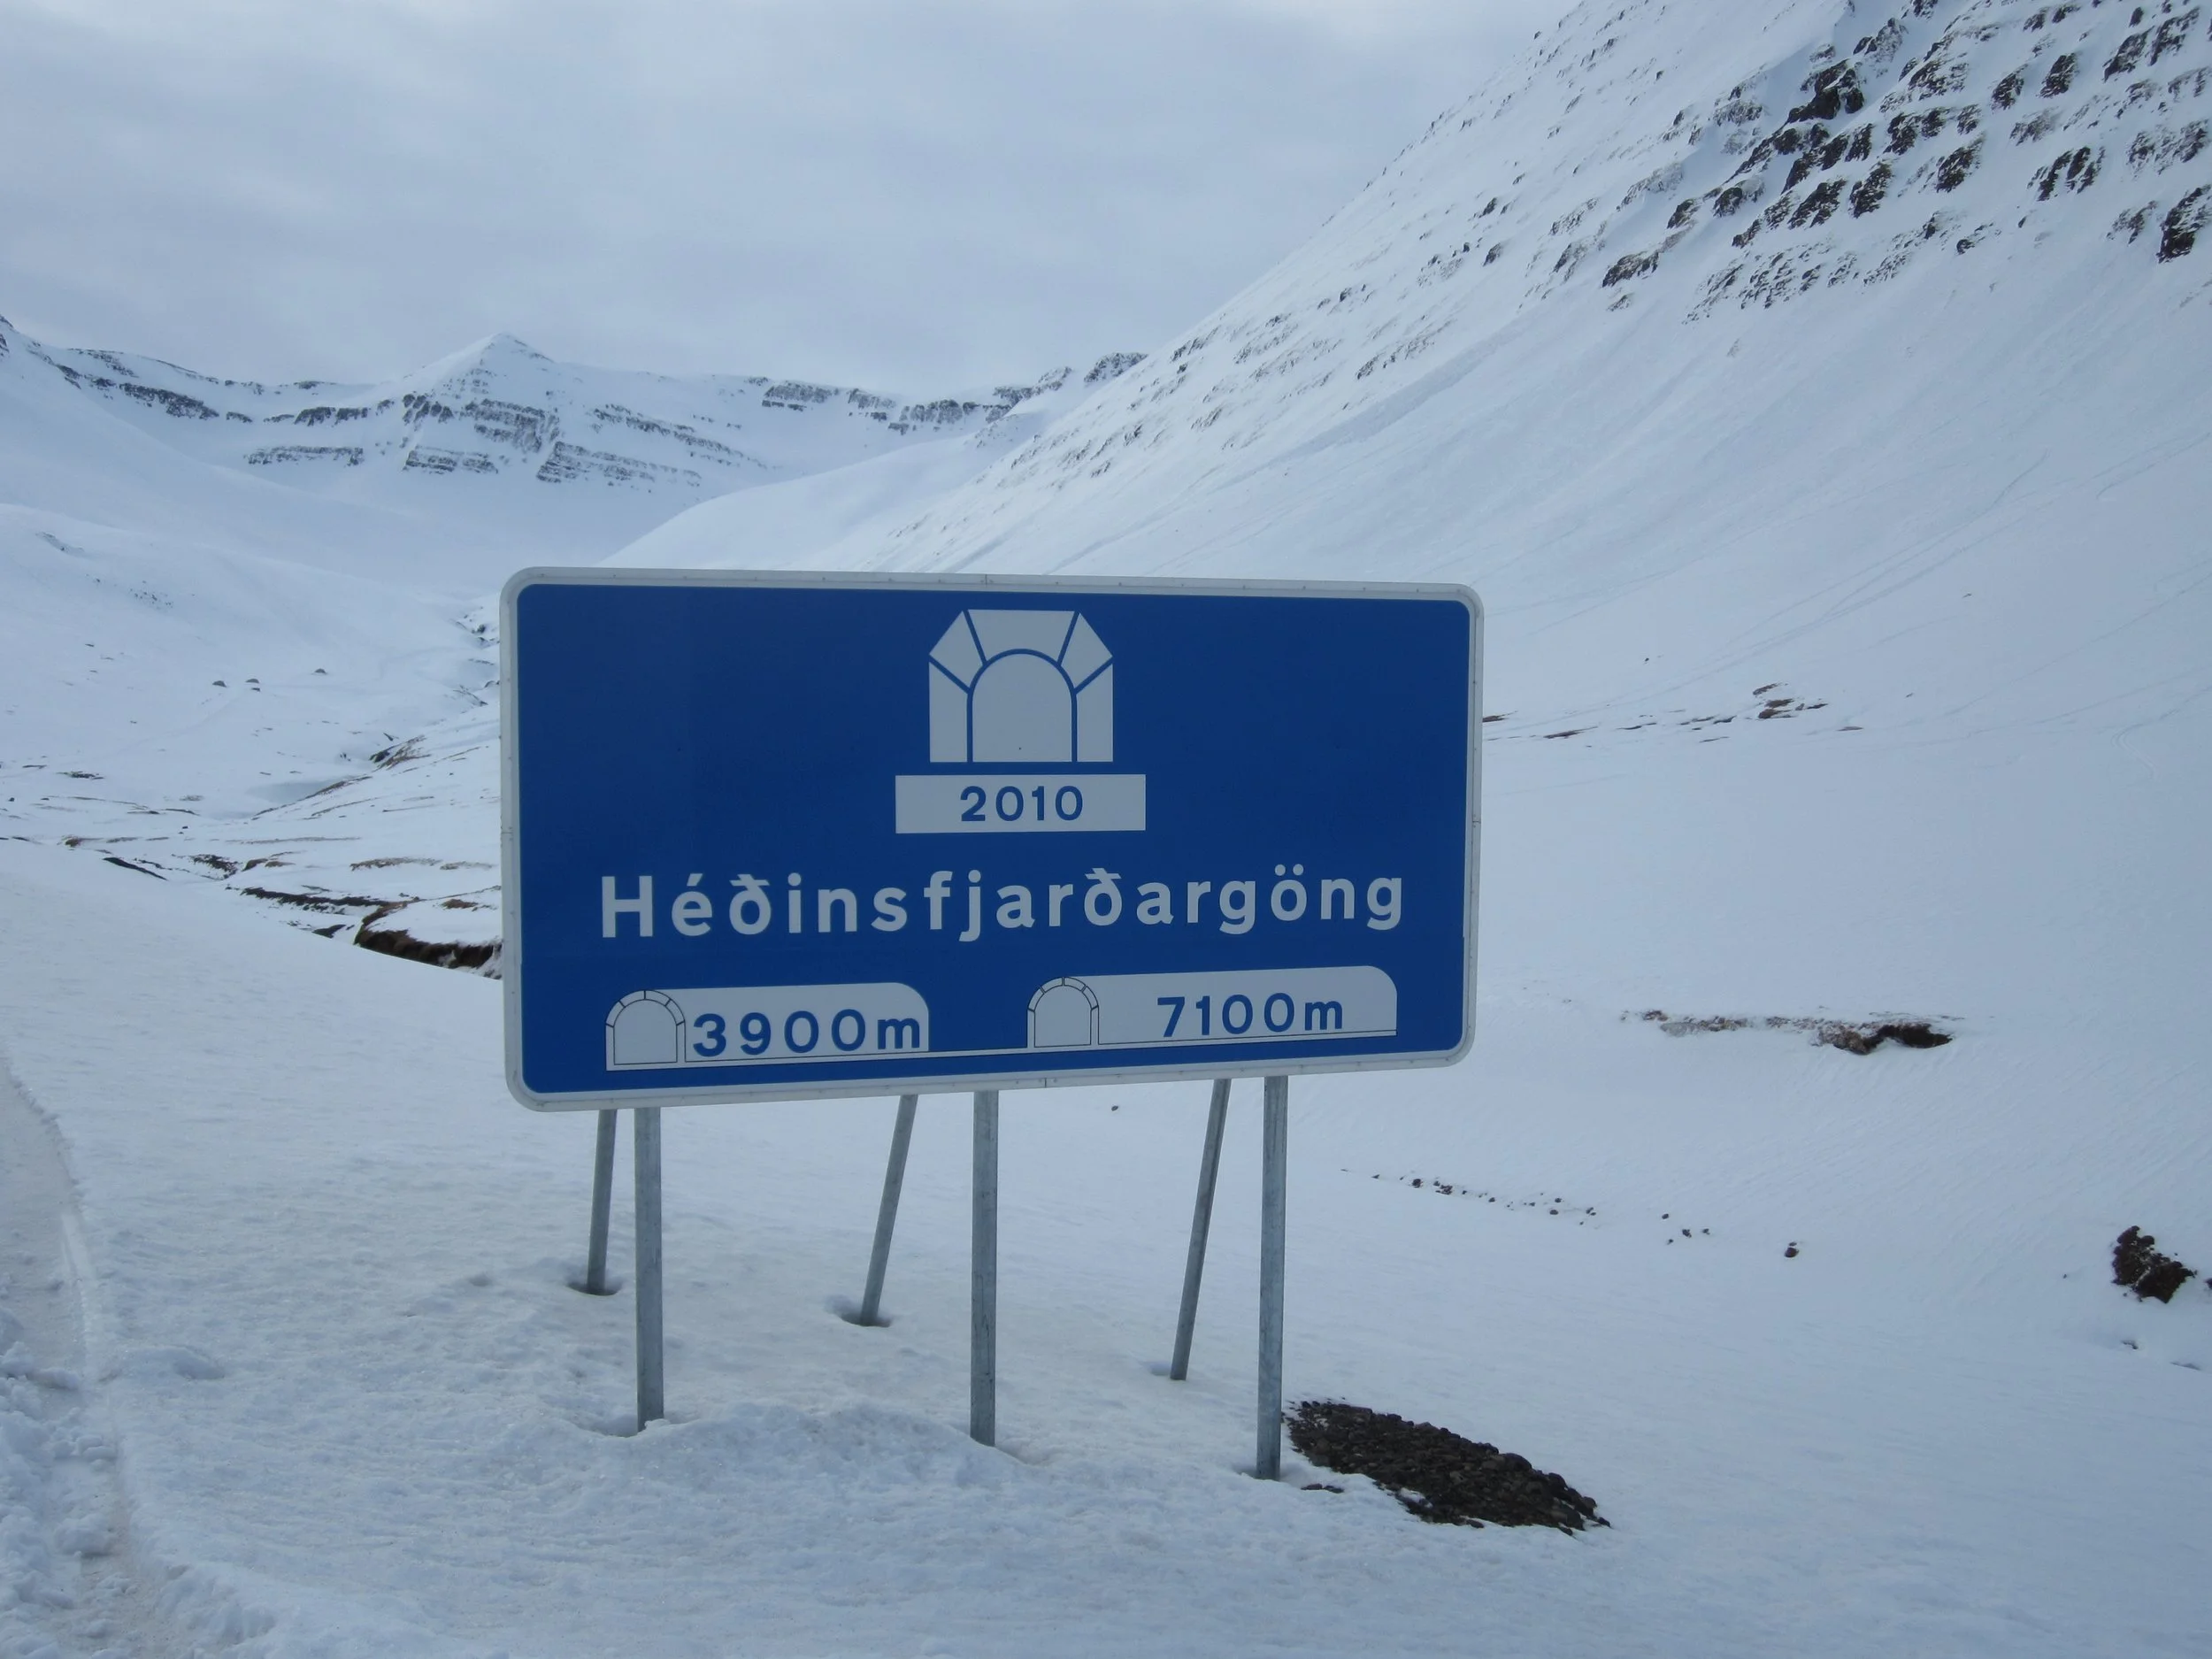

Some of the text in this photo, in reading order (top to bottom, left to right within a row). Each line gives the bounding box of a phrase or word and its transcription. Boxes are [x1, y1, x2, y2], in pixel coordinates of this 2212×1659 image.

[960, 785, 1084, 822] 2010
[601, 864, 1403, 942] Héðinsfjarðargöng
[692, 1009, 920, 1057] 3900m
[1156, 992, 1343, 1038] 7100m
